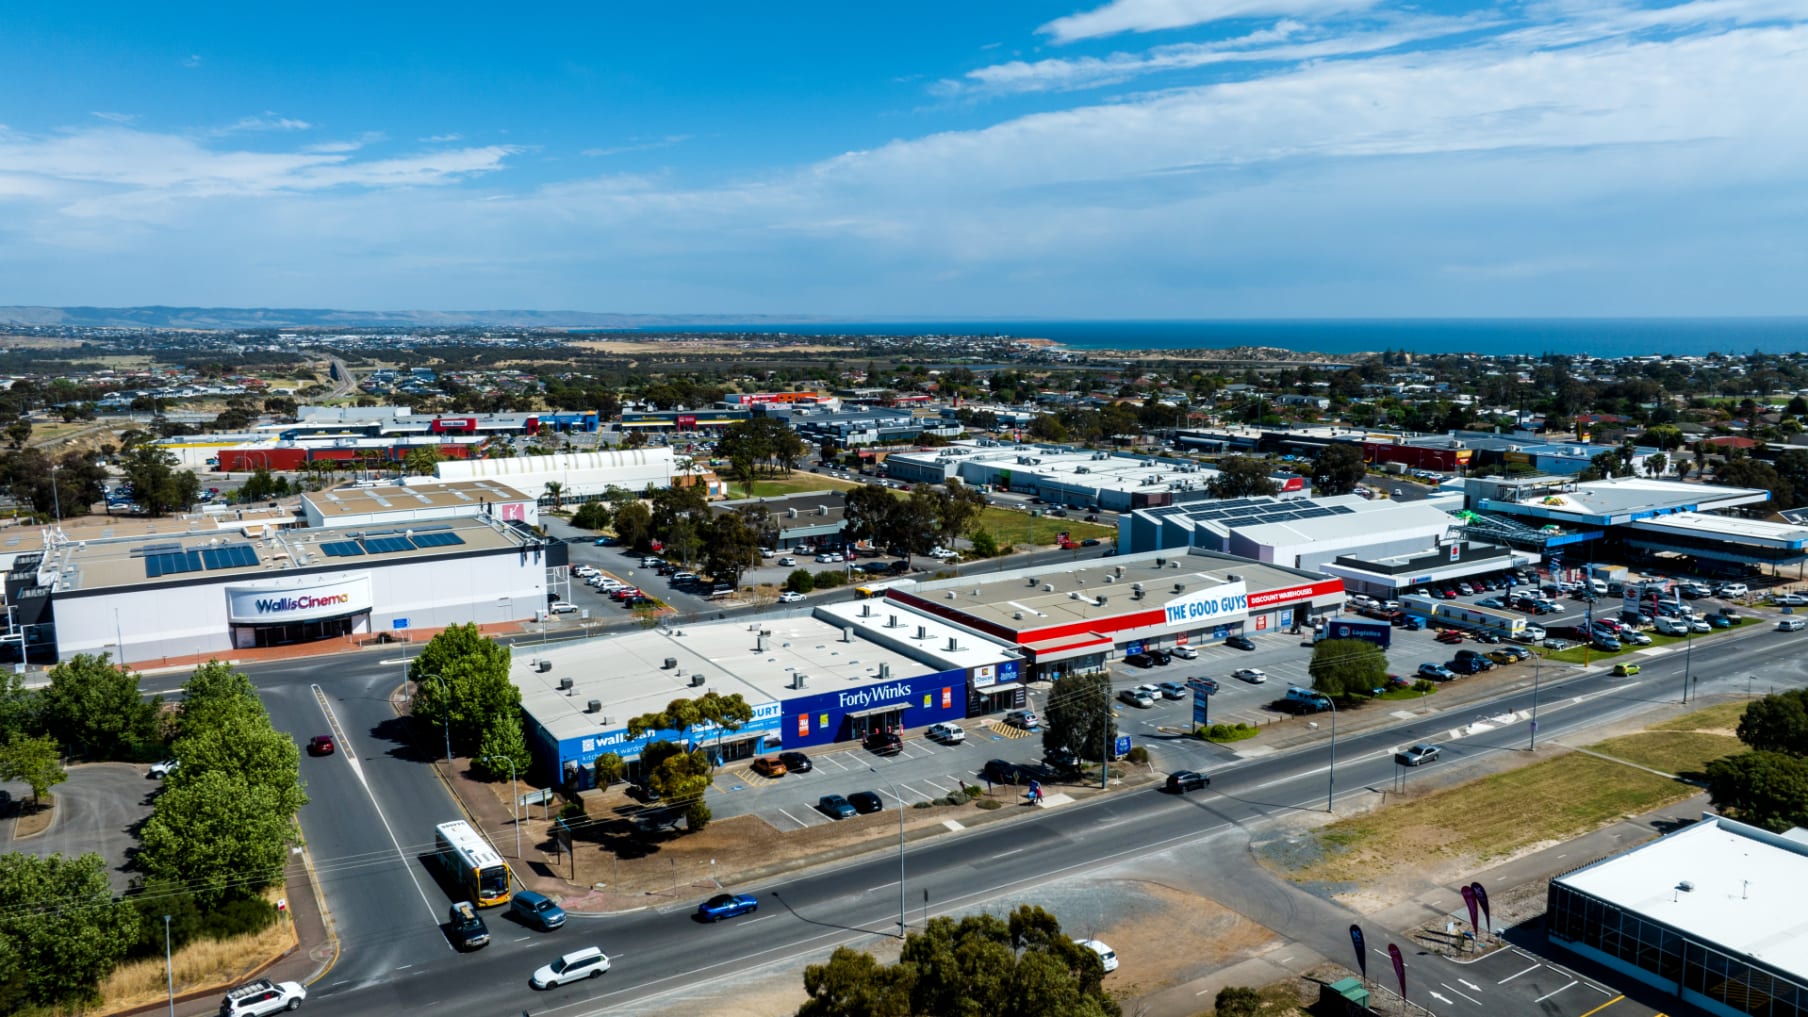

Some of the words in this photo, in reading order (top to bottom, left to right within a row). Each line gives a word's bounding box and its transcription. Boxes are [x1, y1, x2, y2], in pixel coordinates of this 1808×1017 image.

[1166, 604, 1187, 622] THE
[1189, 600, 1219, 617] GOOD
[1221, 594, 1247, 612] GUYS
[1251, 593, 1279, 604] DISCOUNT
